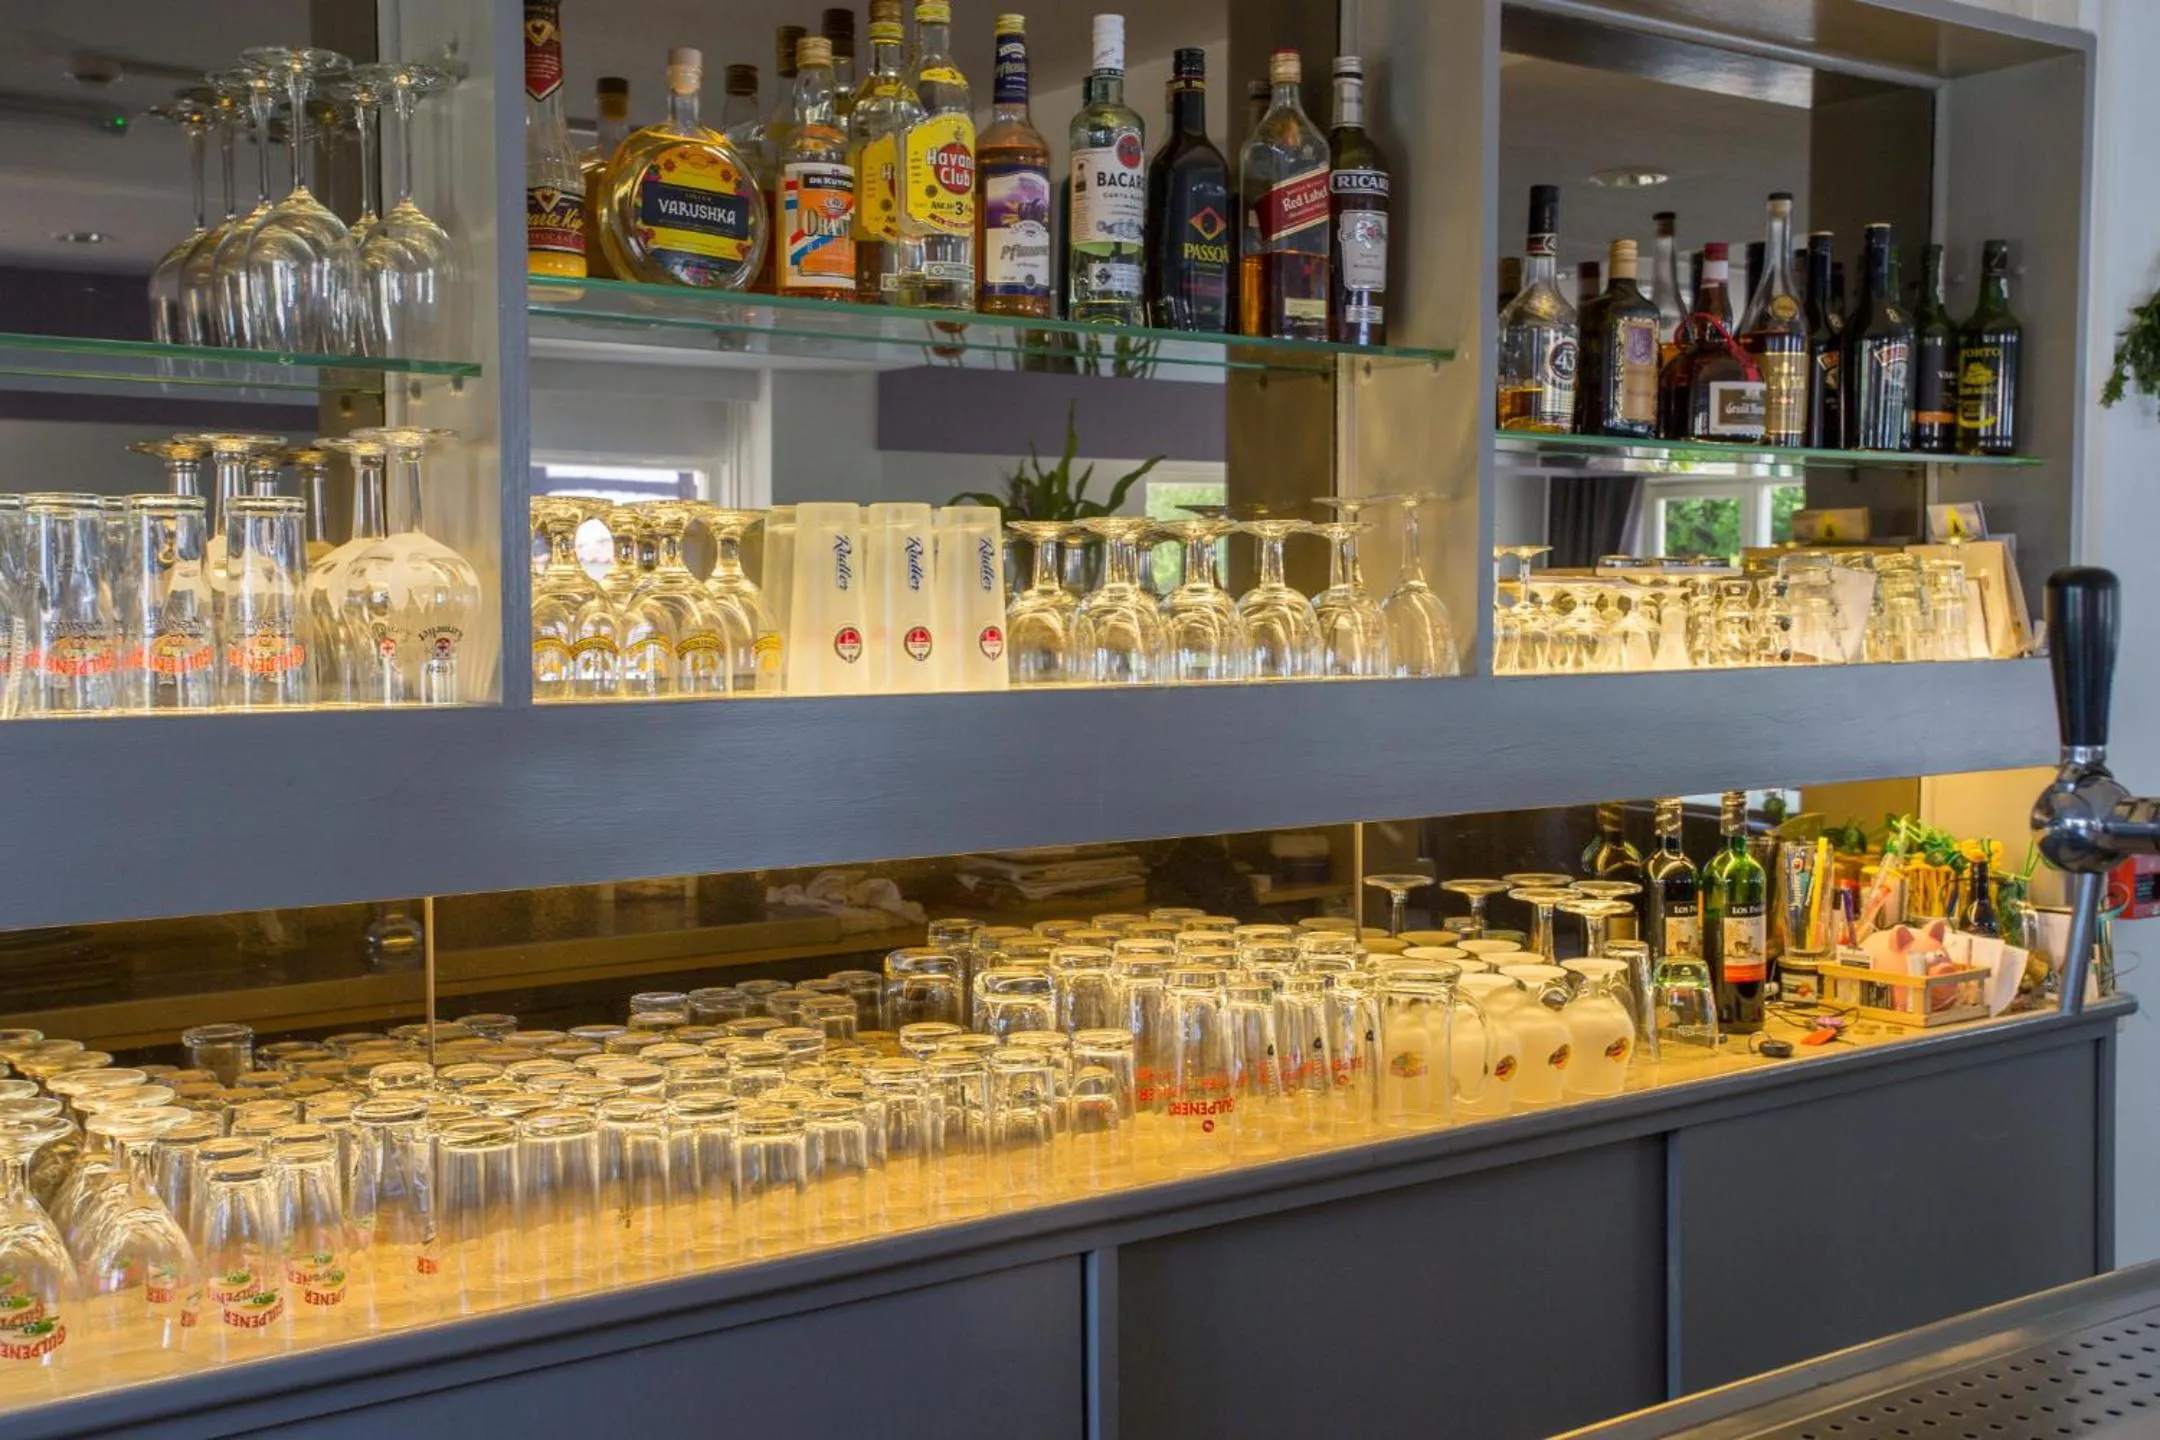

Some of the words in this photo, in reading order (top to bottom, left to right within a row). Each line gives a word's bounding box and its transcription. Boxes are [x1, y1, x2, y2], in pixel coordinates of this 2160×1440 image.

[940, 166, 971, 188] Club
[657, 198, 737, 225] VARUSHKA
[956, 201, 965, 216] 3
[1552, 350, 1577, 369] 43
[833, 534, 852, 592] Radler
[905, 535, 924, 592] Radler
[979, 534, 995, 593] Radler
[0, 1325, 66, 1360] GULPENE
